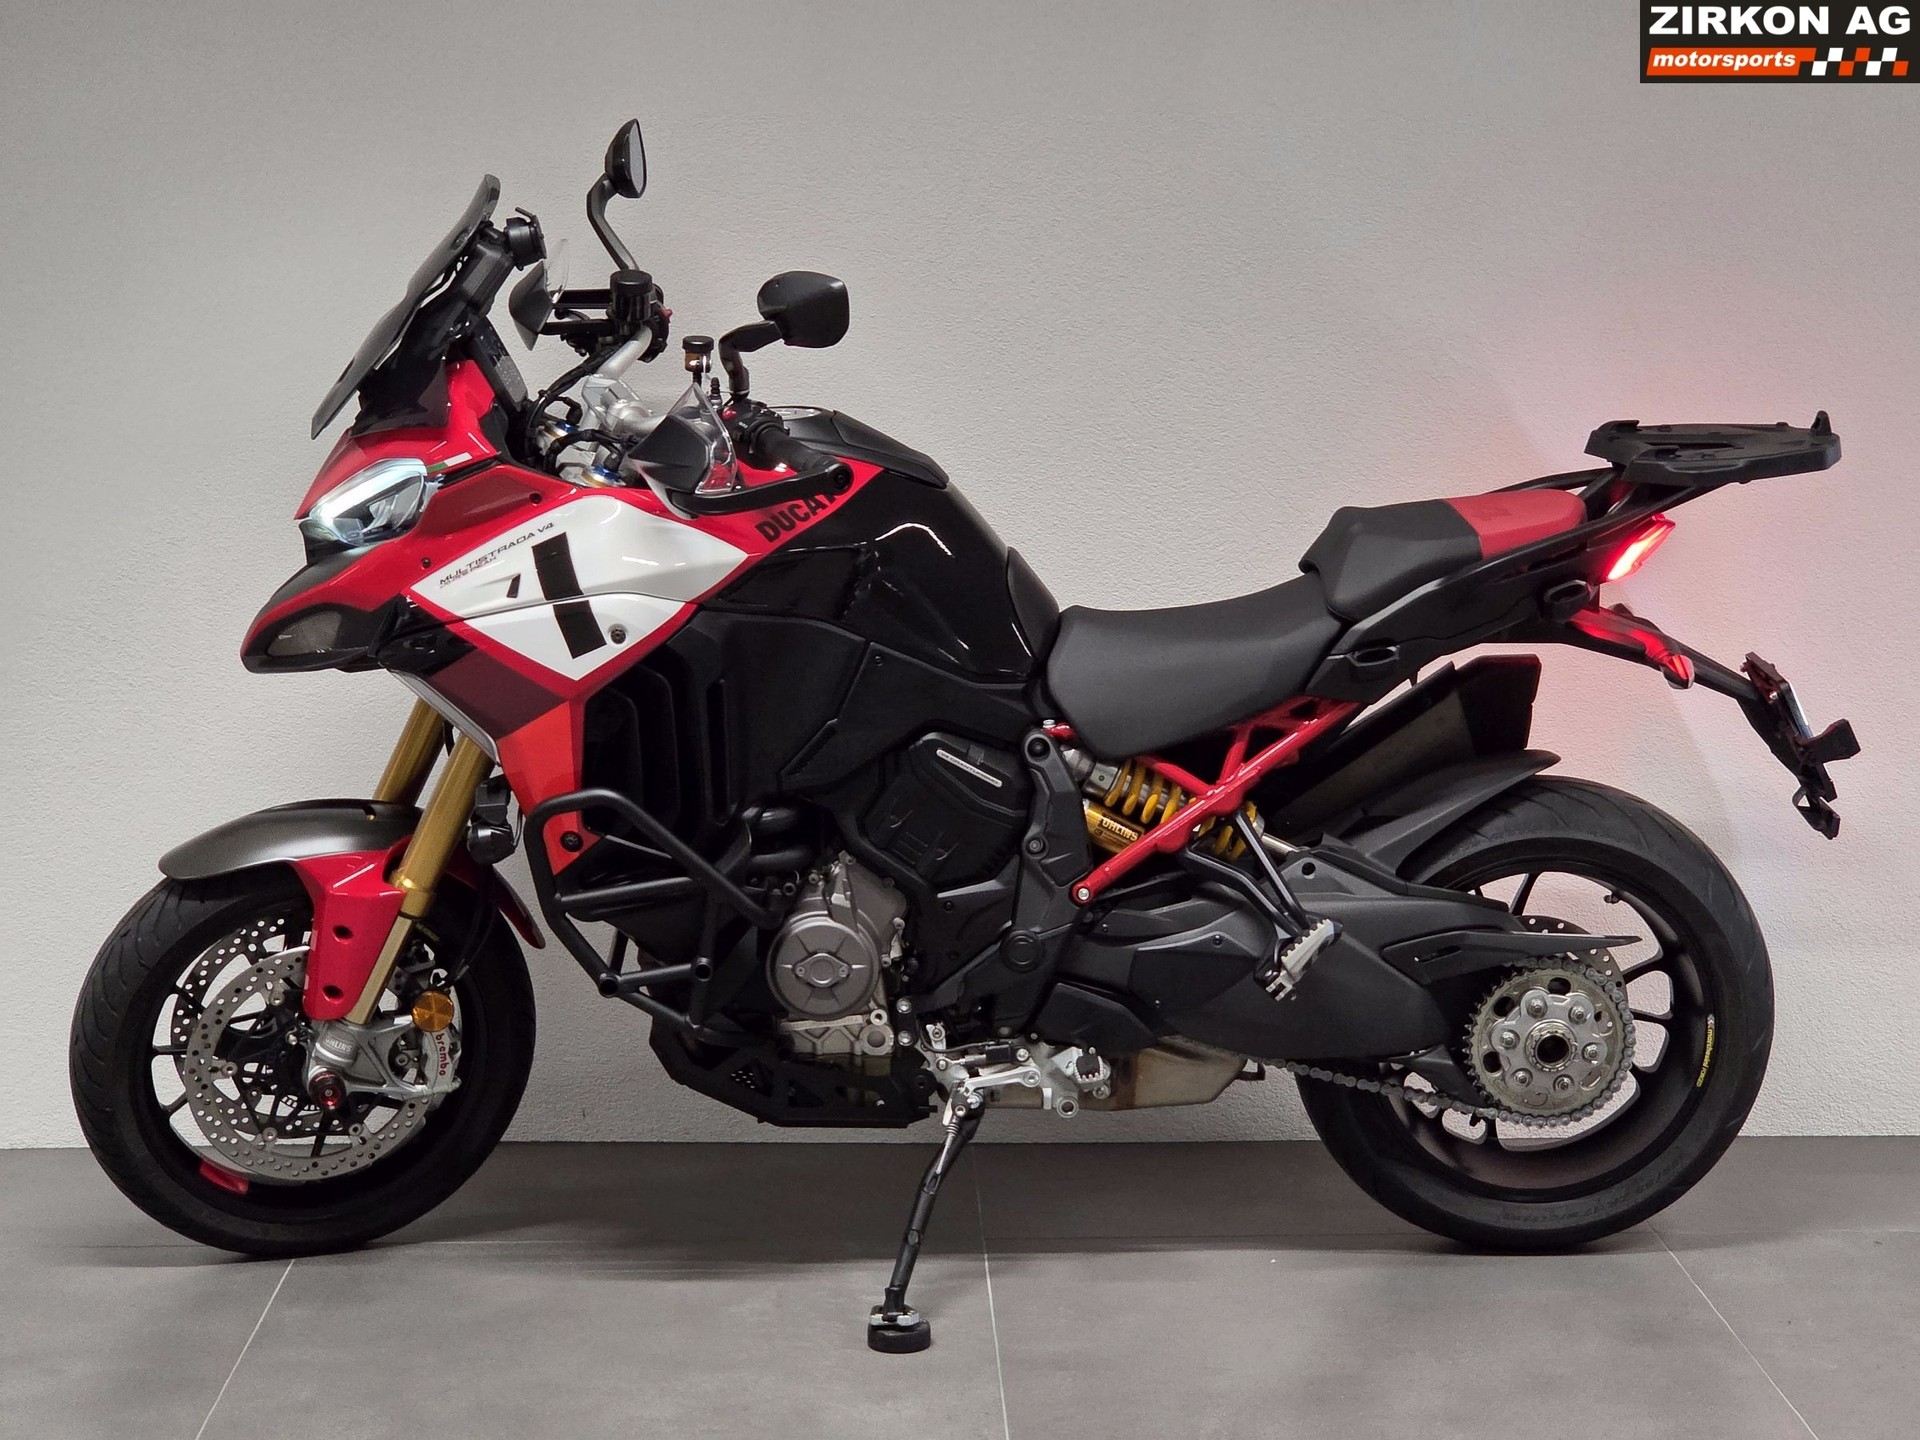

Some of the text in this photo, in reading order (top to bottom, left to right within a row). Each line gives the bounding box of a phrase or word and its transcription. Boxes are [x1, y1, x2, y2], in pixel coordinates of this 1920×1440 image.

[754, 492, 838, 543] DUCA
[439, 521, 555, 585] MULTISTRADA V4
[435, 1033, 447, 1076] brembo
